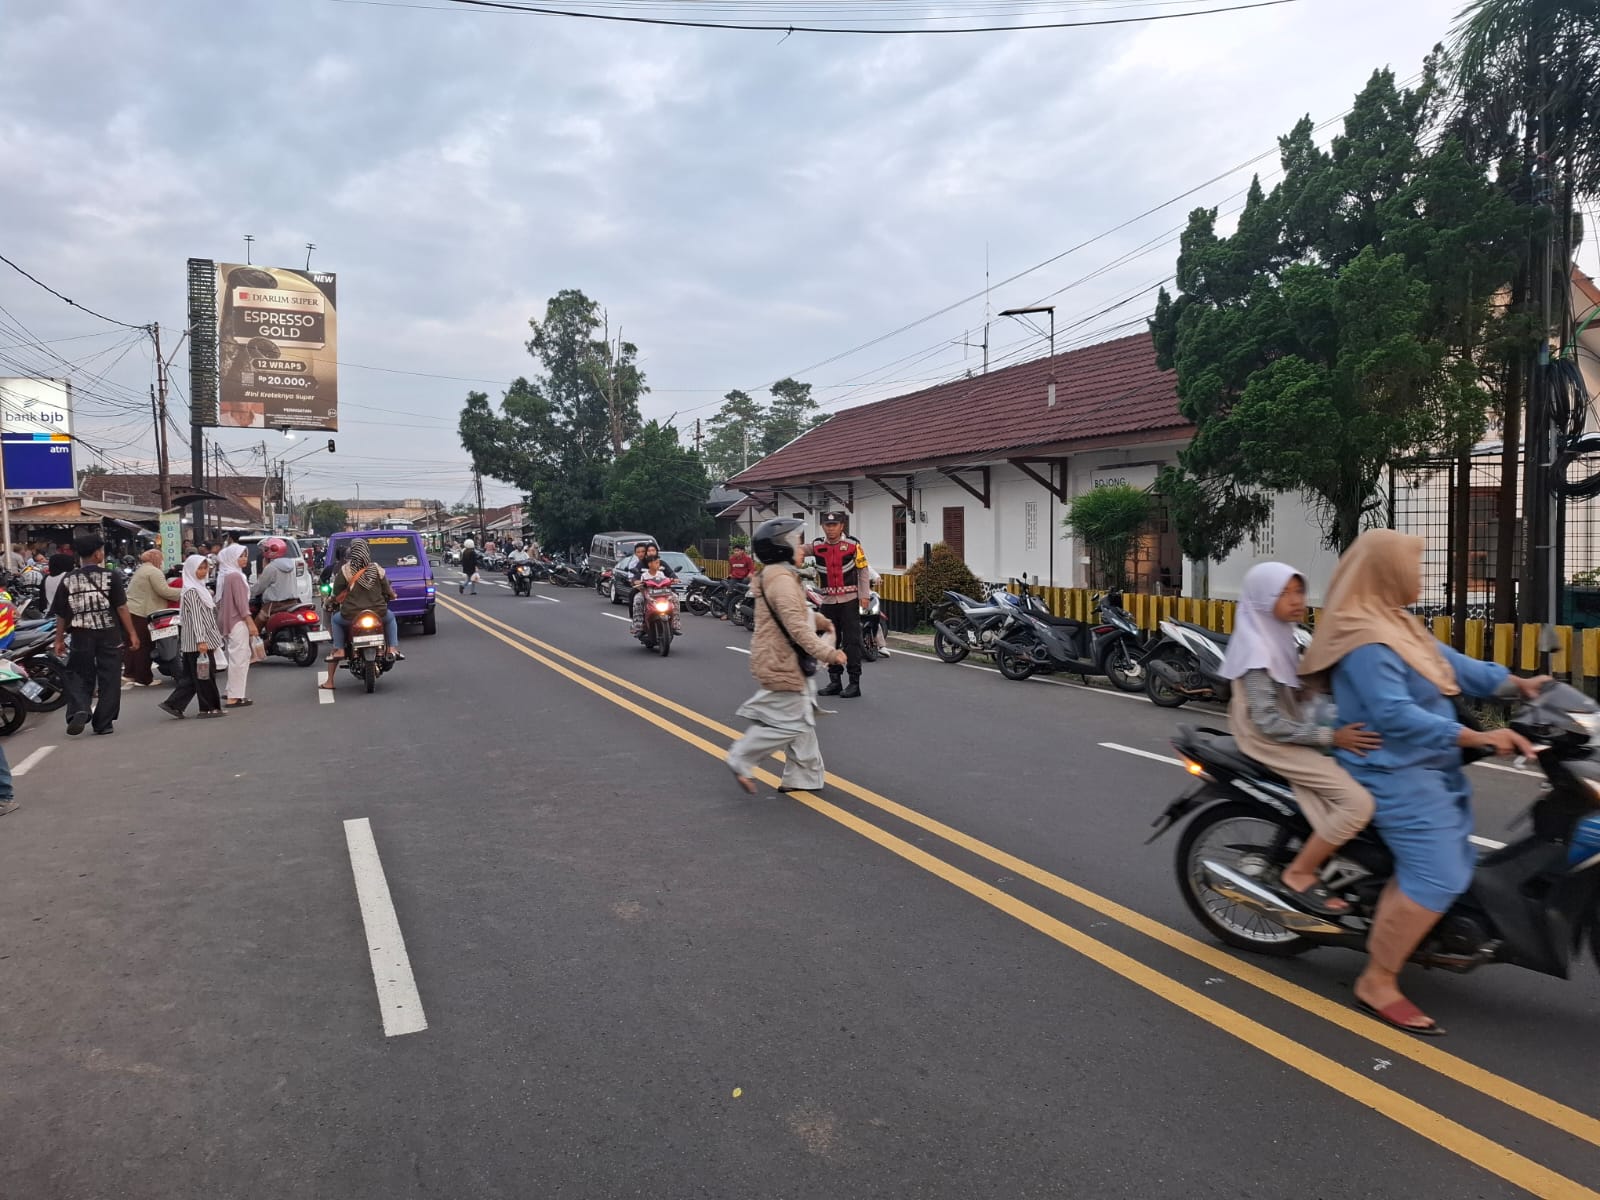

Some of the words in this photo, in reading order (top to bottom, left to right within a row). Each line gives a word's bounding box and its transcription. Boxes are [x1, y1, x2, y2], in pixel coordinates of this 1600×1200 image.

[313, 275, 334, 283] NEW
[252, 294, 289, 303] DJARUM
[291, 297, 319, 306] SUPER
[244, 311, 315, 326] ESPRESSO
[258, 325, 300, 338] GOLD
[257, 360, 267, 368] 12
[269, 361, 302, 370] WRAPS
[258, 375, 267, 383] Rp
[5, 411, 37, 422] bank
[41, 411, 64, 424] bjb
